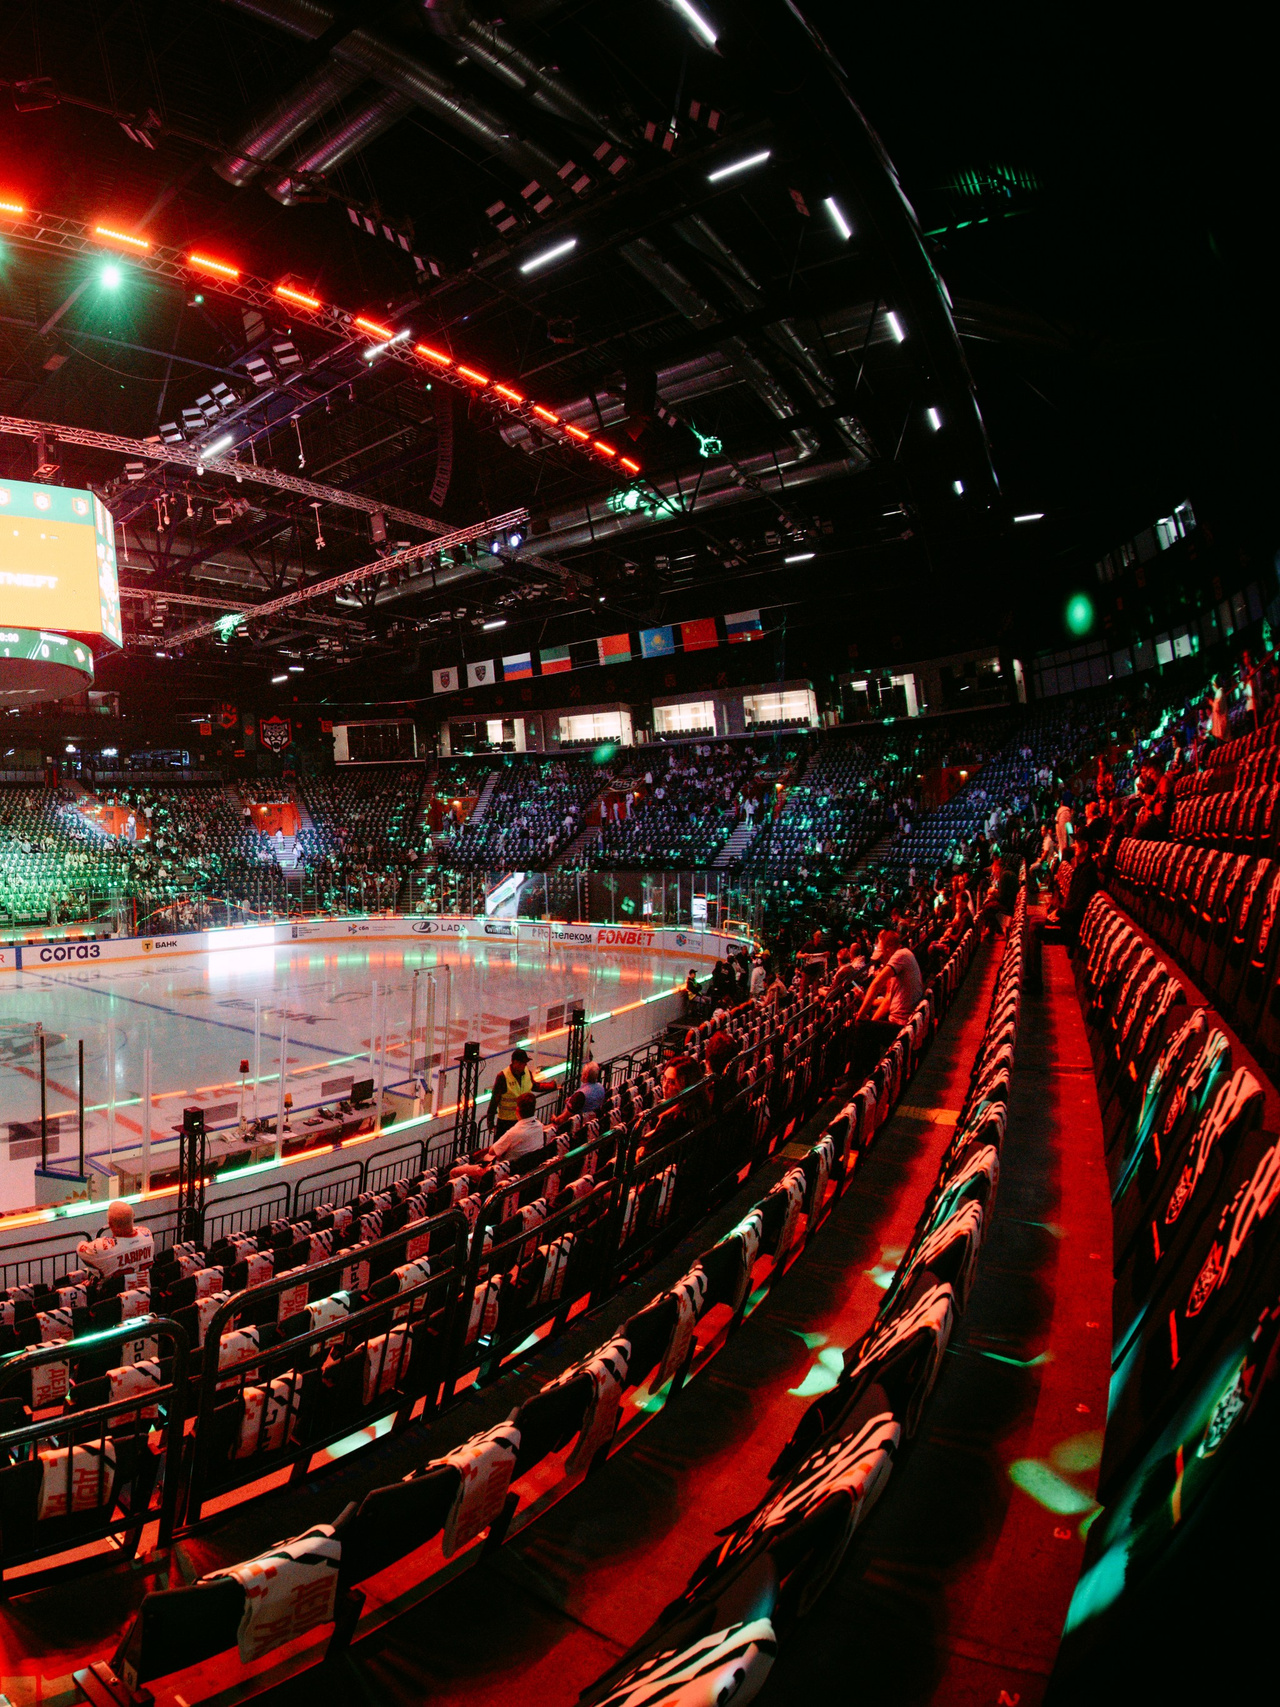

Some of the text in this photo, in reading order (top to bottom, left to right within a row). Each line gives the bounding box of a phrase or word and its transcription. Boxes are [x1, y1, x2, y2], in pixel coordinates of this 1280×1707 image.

[441, 923, 467, 932] LADA
[597, 929, 655, 946] FONBET
[155, 940, 178, 949] БАНК
[117, 1246, 151, 1267] ZARIPOV
